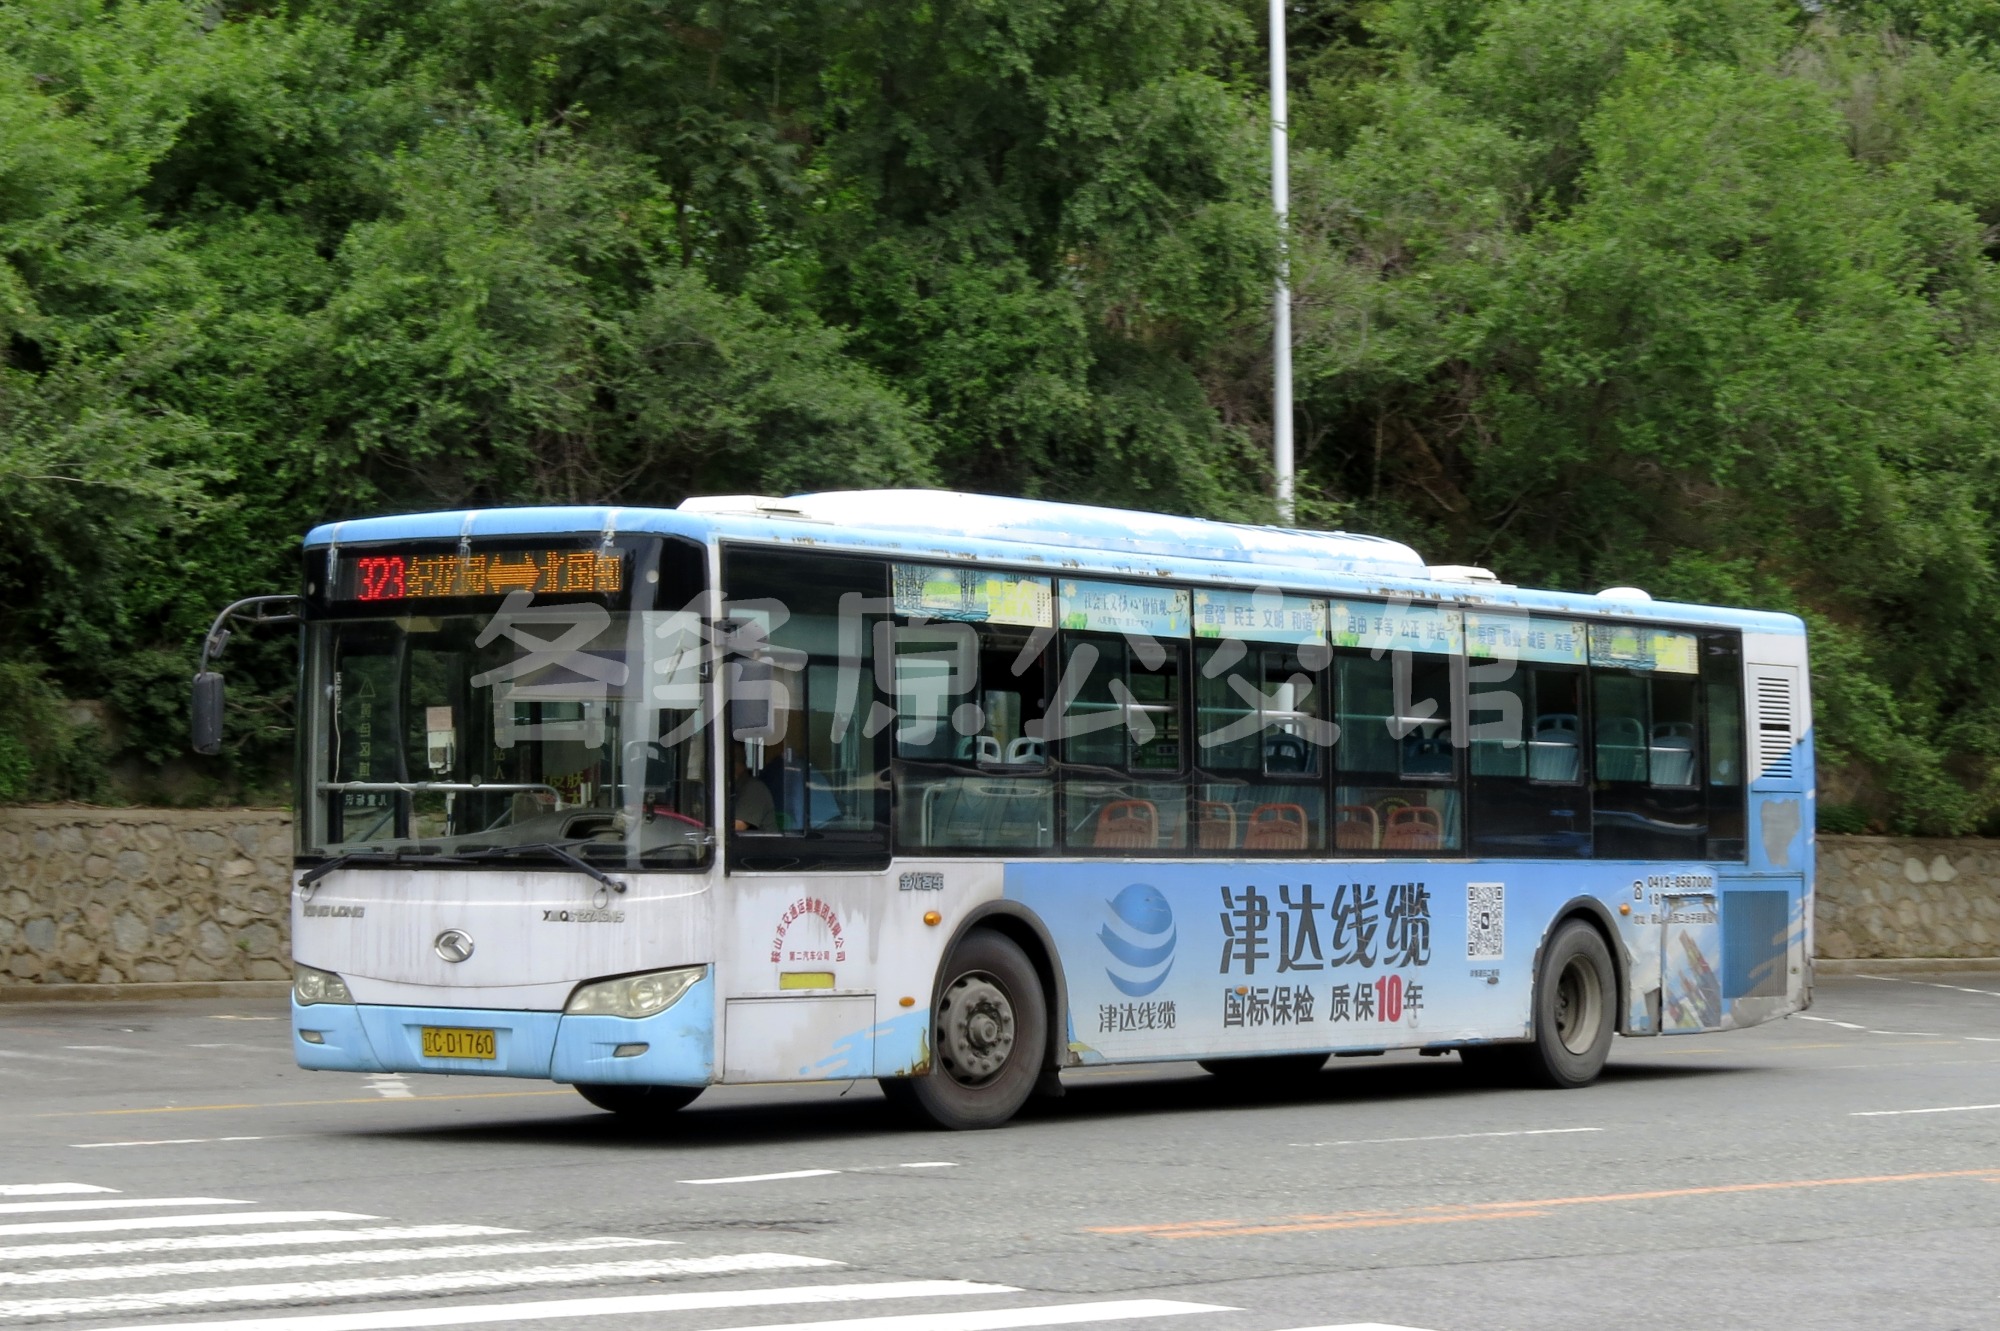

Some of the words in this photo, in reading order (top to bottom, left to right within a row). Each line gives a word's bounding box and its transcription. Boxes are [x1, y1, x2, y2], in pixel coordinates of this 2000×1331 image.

[358, 556, 405, 600] 323
[1084, 592, 1167, 616] 社会主义核心价值观
[1204, 604, 1226, 625] 富强
[1234, 606, 1255, 627] 民主
[1263, 608, 1284, 629] 文明
[1292, 611, 1313, 631] 和谐
[1348, 616, 1367, 634] 自由
[1374, 617, 1393, 636] 平等
[1401, 620, 1420, 638] 公正
[1426, 621, 1445, 640] 法治
[1478, 626, 1496, 645] 爱国
[1528, 631, 1545, 650] 诚信
[1554, 633, 1573, 652] 友善
[899, 872, 944, 891] 金龙客车
[771, 896, 845, 963] 鞍山市交通运输集团有限公司
[1219, 882, 1431, 975] 津达线缆
[789, 950, 830, 961] 第二汽车公司
[1223, 985, 1315, 1028] 国标保检
[1329, 974, 1424, 1024] 质保10年
[1099, 1000, 1176, 1032] 津达线缆
